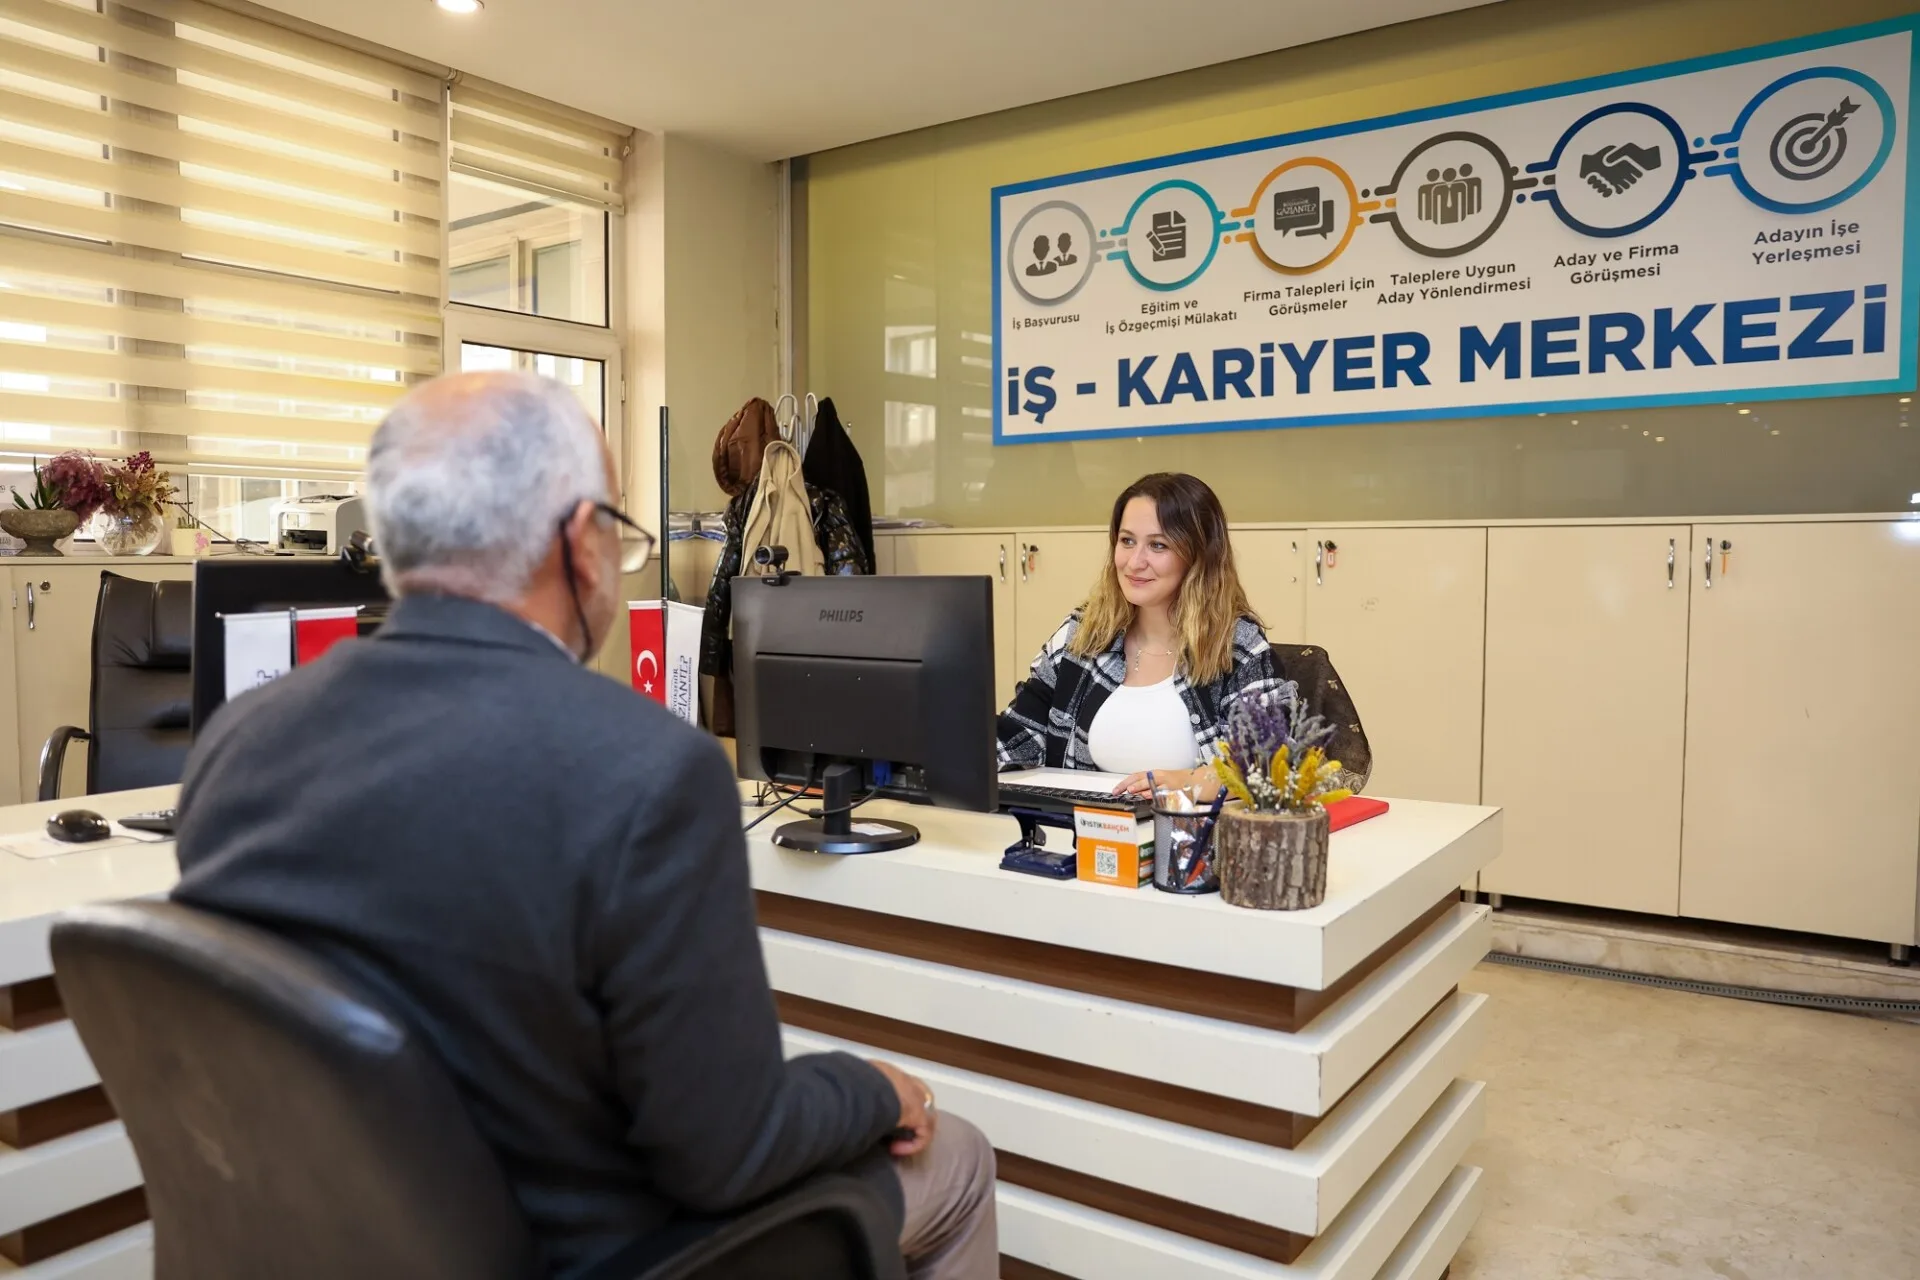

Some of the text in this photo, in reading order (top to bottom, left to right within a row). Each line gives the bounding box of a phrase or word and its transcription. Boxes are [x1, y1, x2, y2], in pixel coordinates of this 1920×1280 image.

[1754, 219, 1860, 245] Adayın İşe
[1554, 244, 1679, 268] Aday ve Firma
[1752, 240, 1861, 265] Yerleşmesi
[1391, 264, 1516, 288] Taleplere Uygun
[1570, 263, 1661, 285] Görüşmesi
[1243, 276, 1375, 303] Firma Talepleri İçin
[1377, 277, 1531, 305] Aday Yönlendirmesi
[1141, 299, 1199, 316] Eğitim ve
[1268, 298, 1348, 316] Görüşmeler
[1012, 313, 1080, 331] İş Başvurusu
[1105, 310, 1237, 335] İş Özgeçmişi Mülakatı
[1008, 365, 1057, 424] İŞ
[1118, 331, 1432, 408] KARİYER
[1459, 283, 1888, 384] MERKEZİ
[819, 609, 864, 623] PHILIPS
